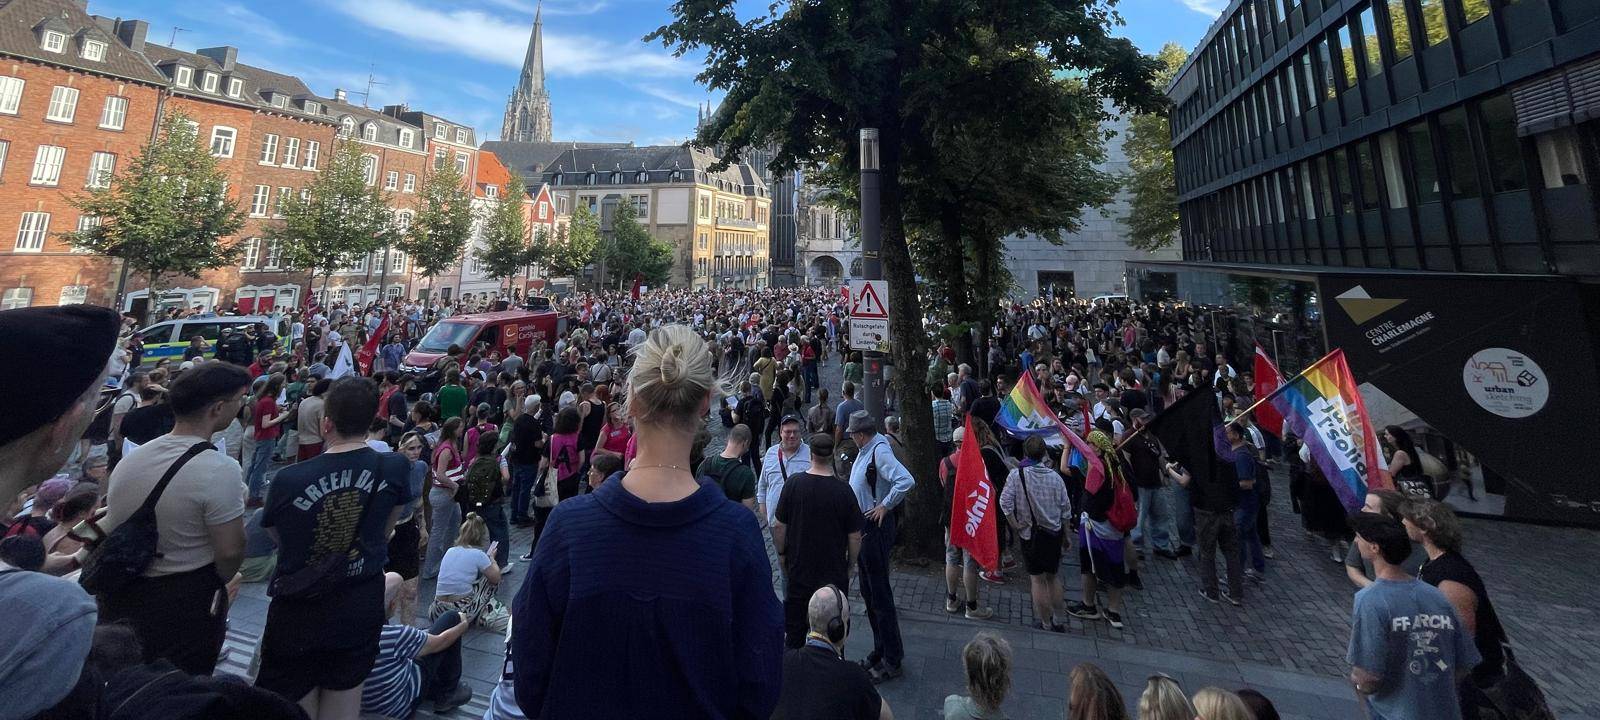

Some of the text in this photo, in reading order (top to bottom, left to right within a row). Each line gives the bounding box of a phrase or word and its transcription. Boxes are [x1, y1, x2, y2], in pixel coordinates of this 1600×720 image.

[1365, 320, 1396, 339] CENTRE
[1371, 311, 1435, 346] CHARLEMAGNE
[1484, 385, 1515, 394] urban
[292, 469, 389, 511] GREEN DAY
[1392, 616, 1411, 632] FF
